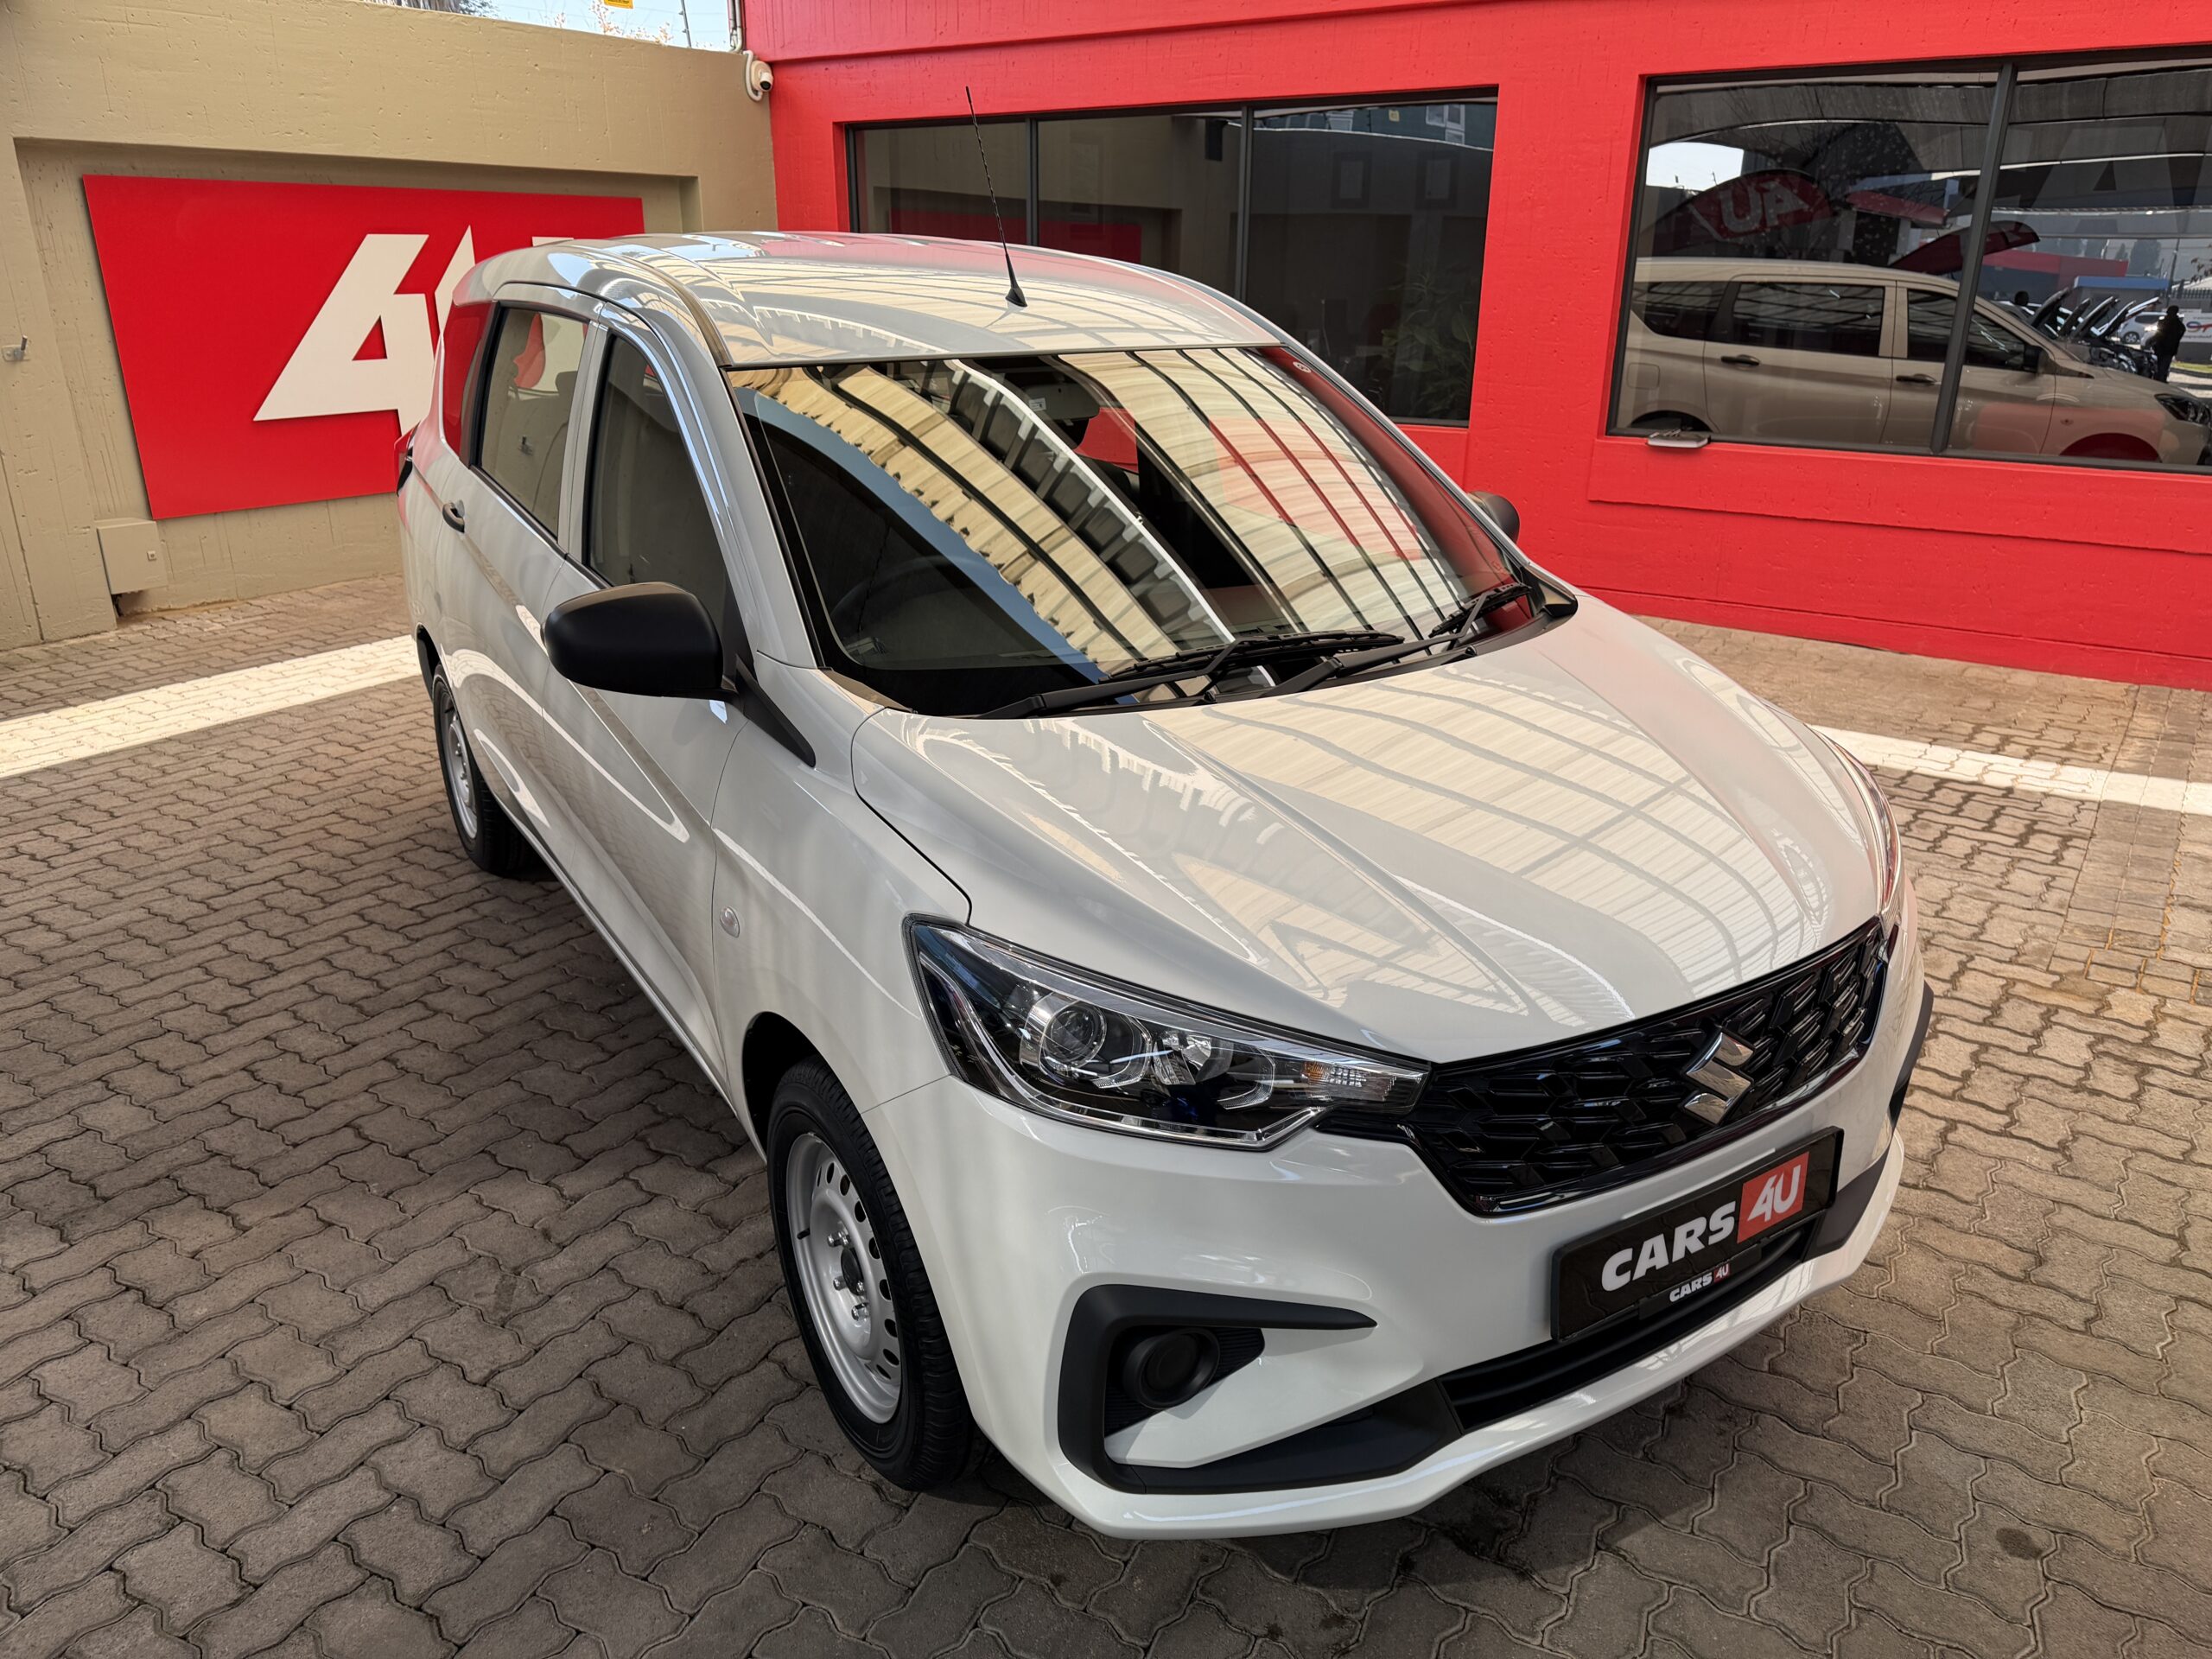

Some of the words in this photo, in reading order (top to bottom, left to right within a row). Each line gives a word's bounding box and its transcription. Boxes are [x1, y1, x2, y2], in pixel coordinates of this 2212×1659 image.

[1601, 1200, 1736, 1292] CARS
[1747, 1164, 1802, 1222] 4U
[1669, 1272, 1713, 1302] CARS
[1716, 1262, 1729, 1278] 4U
